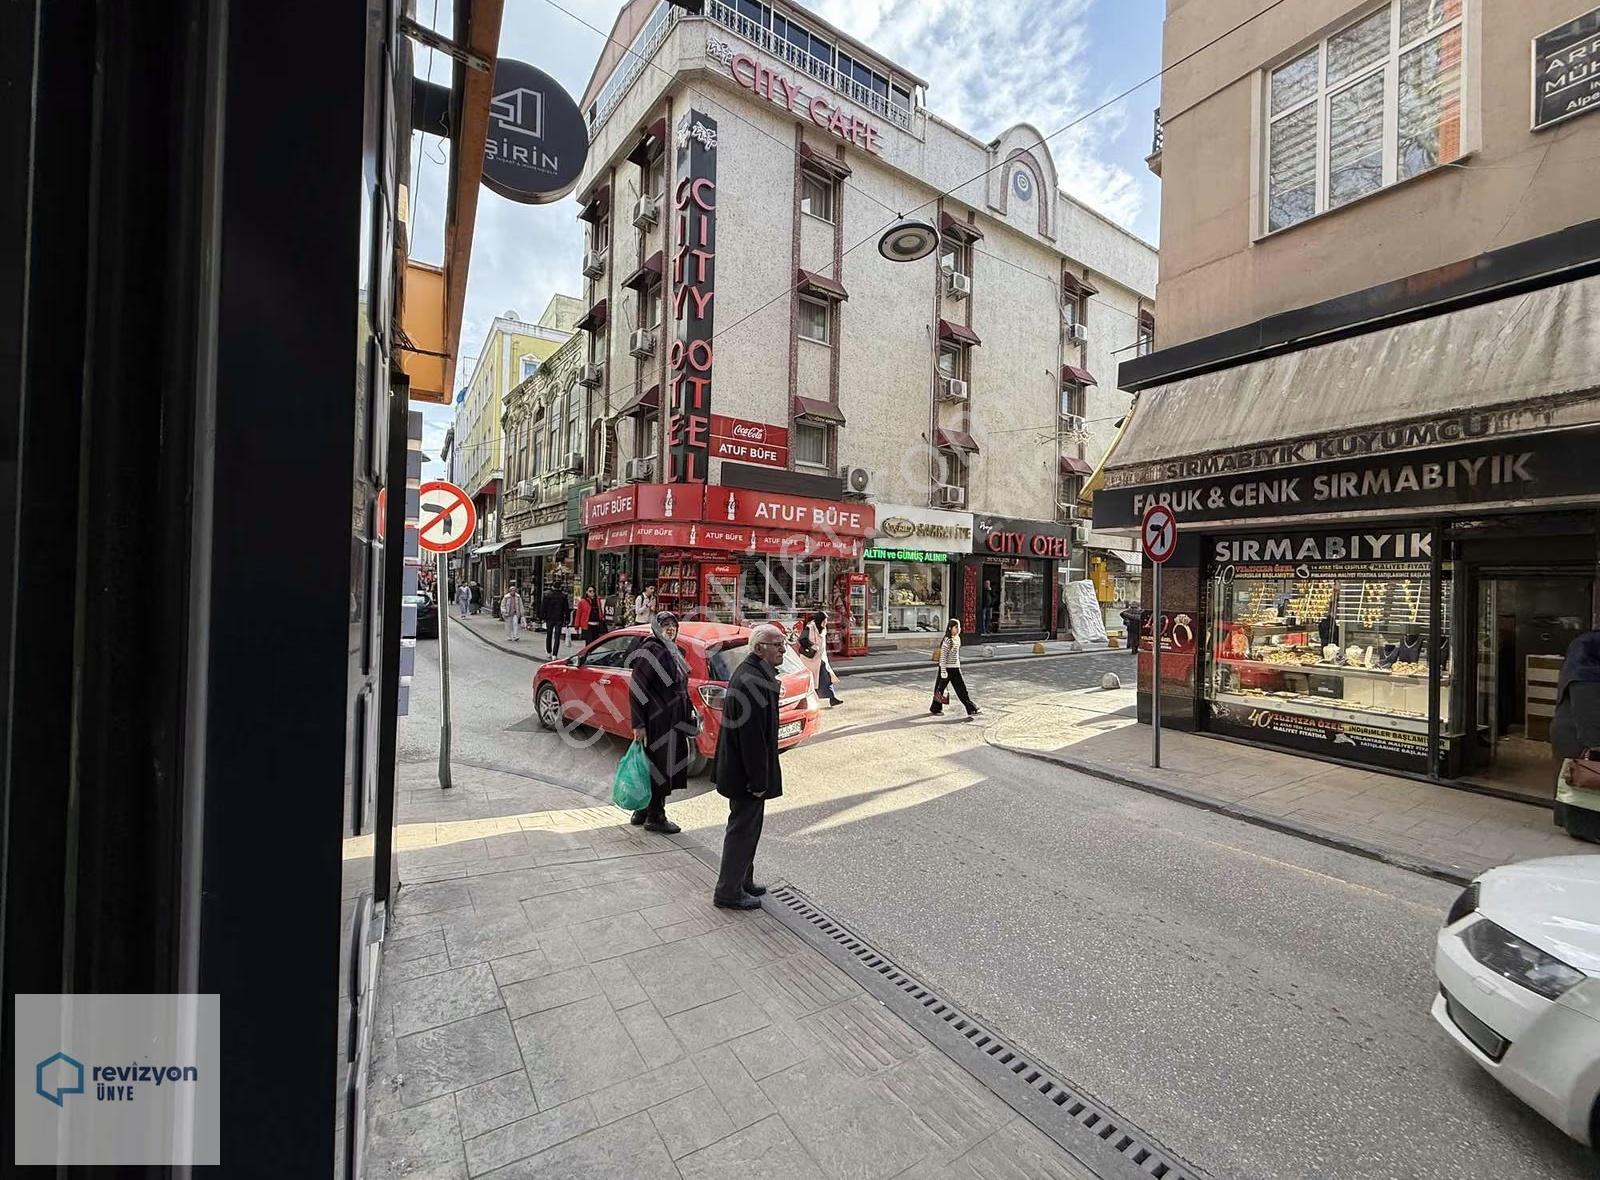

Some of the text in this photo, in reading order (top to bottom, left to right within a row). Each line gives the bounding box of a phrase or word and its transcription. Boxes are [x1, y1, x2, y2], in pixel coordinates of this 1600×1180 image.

[730, 52, 881, 155] CITY CAFE
[689, 177, 716, 320] CITY
[686, 339, 713, 484] OTEL
[719, 443, 777, 461] ATUF BÜFE
[1208, 486, 1226, 508] &
[1230, 477, 1300, 507] CENK
[1314, 452, 1535, 501] SIRMABIYIK
[592, 496, 632, 518] ATUF BÜFE
[755, 502, 807, 522] ATUF
[813, 506, 860, 529] BÜFE
[705, 532, 743, 541] ATUF BÜFE
[987, 531, 1070, 557] CITY OTEL
[1215, 532, 1432, 561] SIRMABIYIK
[863, 549, 886, 558] ALTIN
